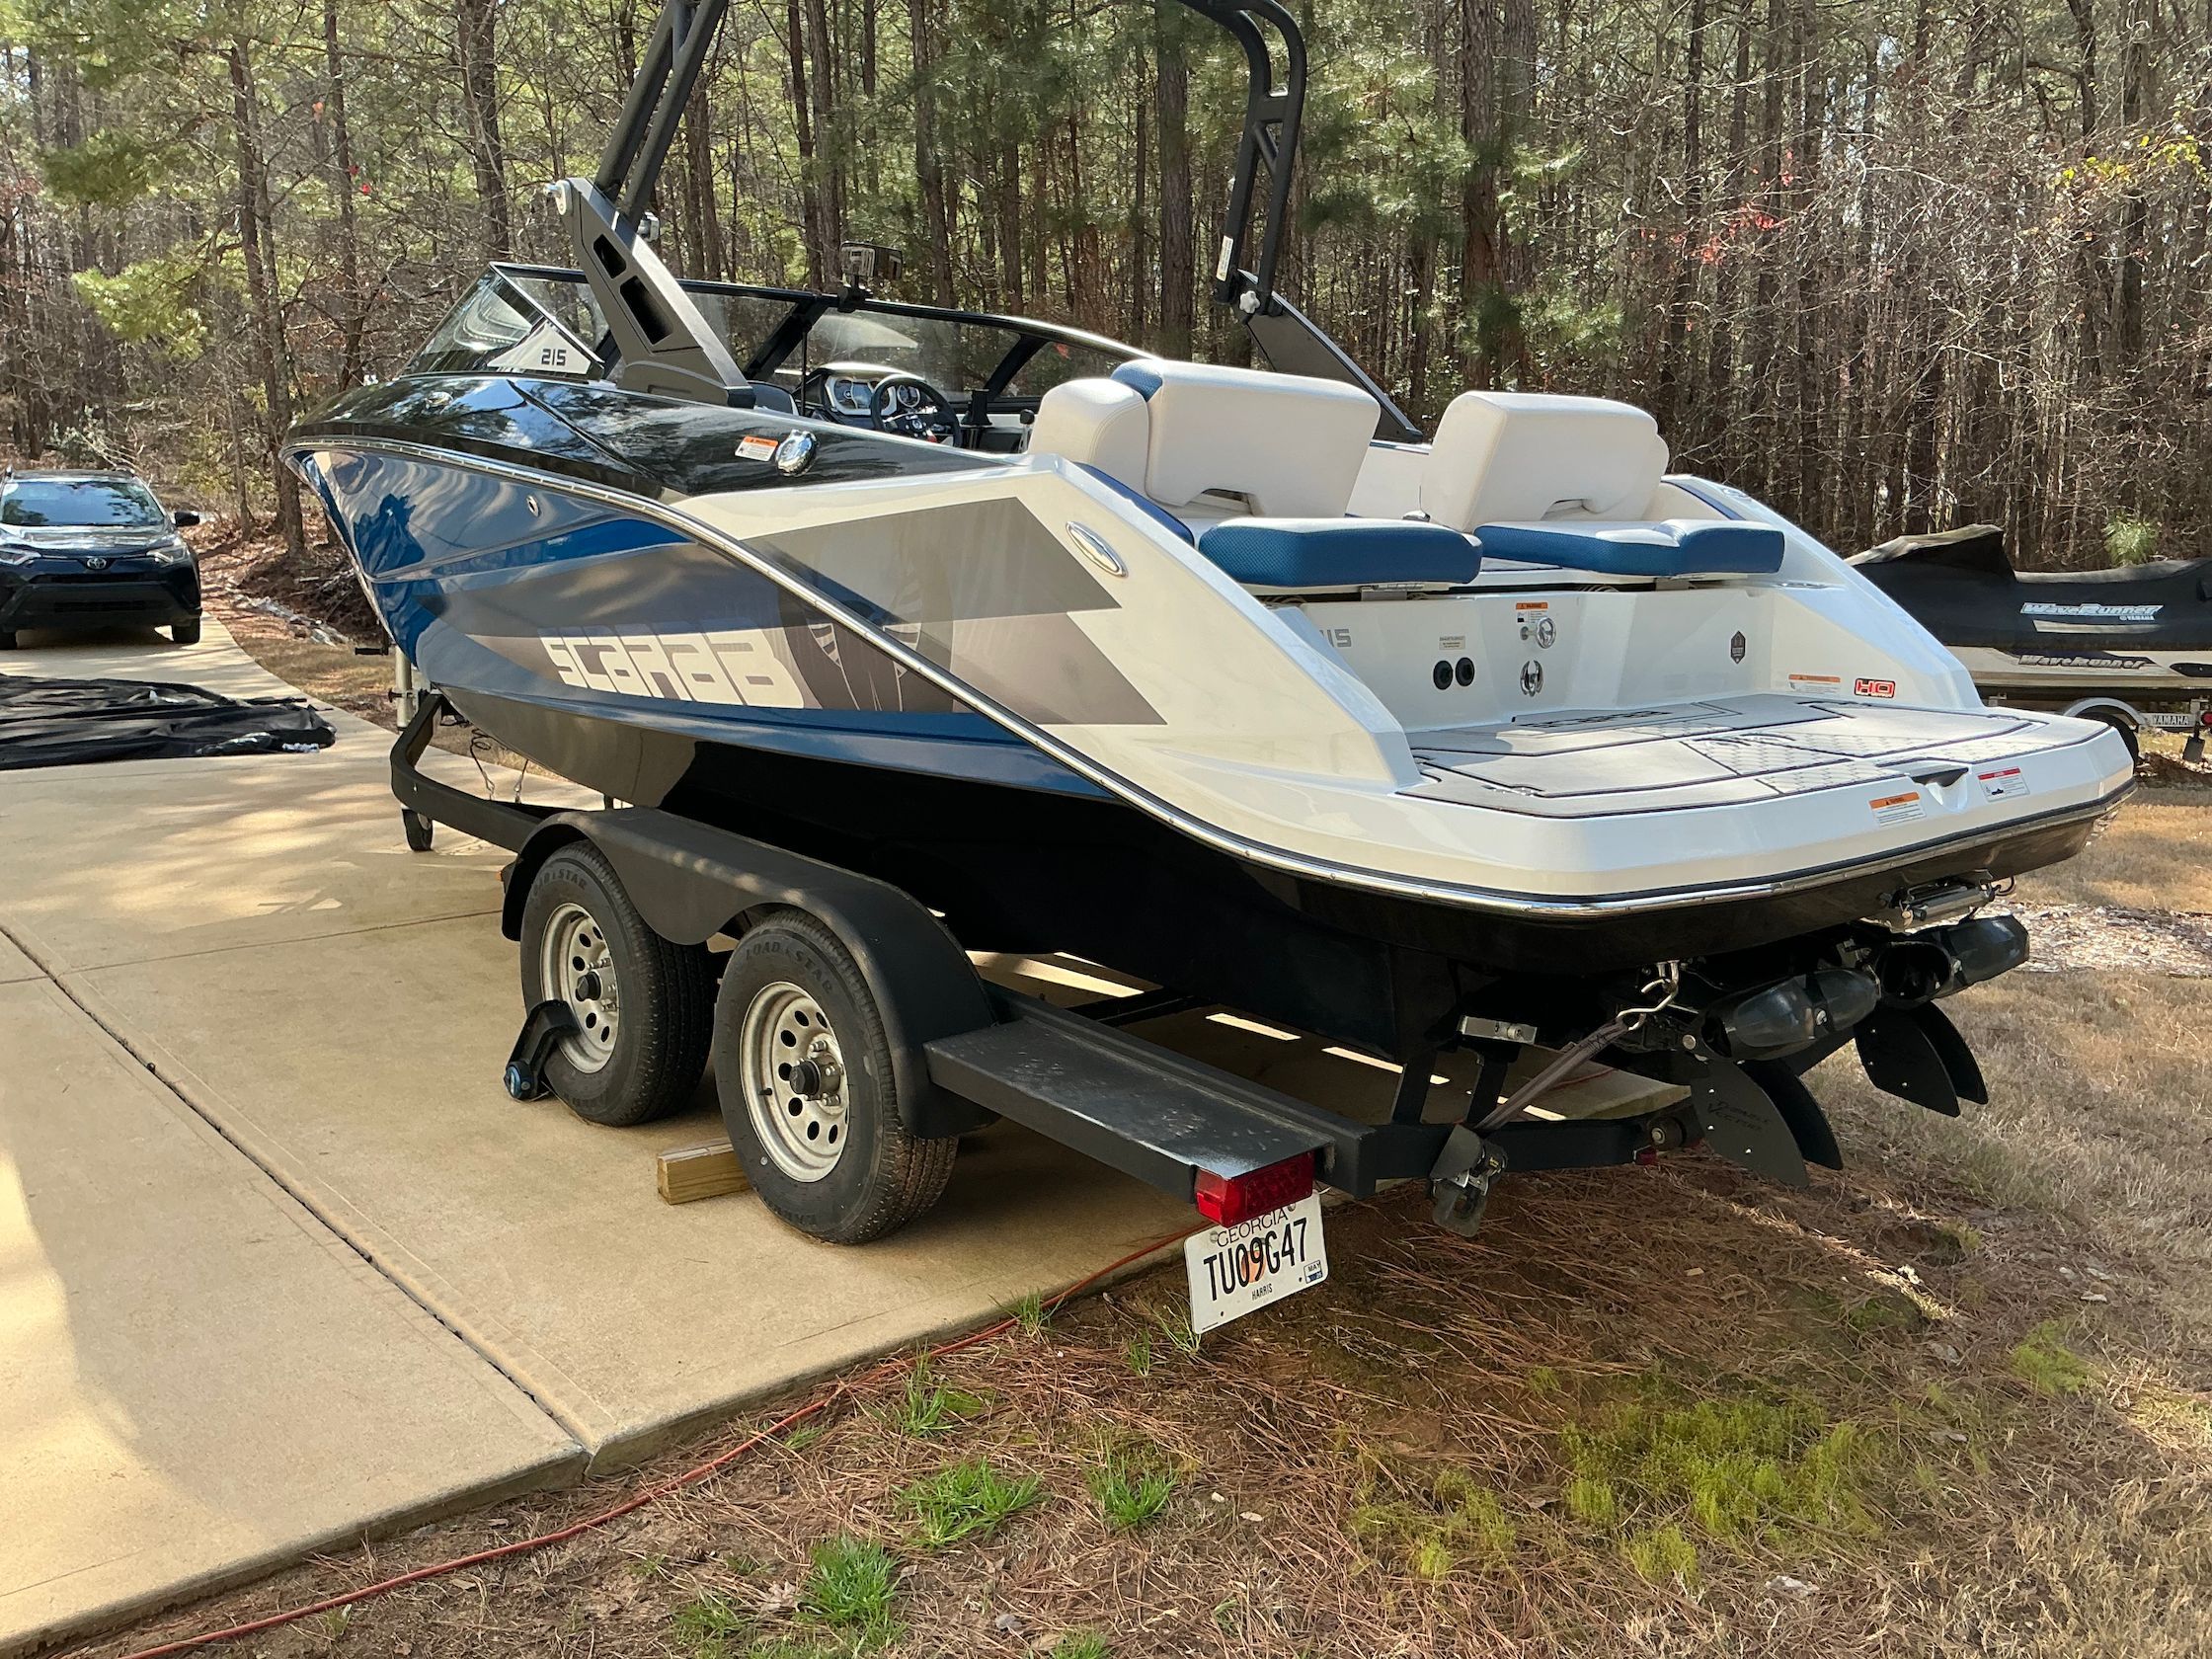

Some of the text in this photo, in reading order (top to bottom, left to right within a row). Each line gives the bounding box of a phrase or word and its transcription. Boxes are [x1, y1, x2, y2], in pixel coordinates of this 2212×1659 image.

[541, 348, 567, 366] 215
[2020, 602, 2164, 616] WaveRunner
[1319, 629, 1352, 648] 15
[538, 621, 805, 709] SCARAB
[2017, 655, 2145, 670] WaveRunner
[1855, 679, 1894, 695] HO
[2152, 712, 2190, 726] YAMAHA
[1217, 1208, 1289, 1248] GEORGIA
[1203, 1217, 1307, 1302] TU09G47
[1251, 1283, 1274, 1301] HARRIS
